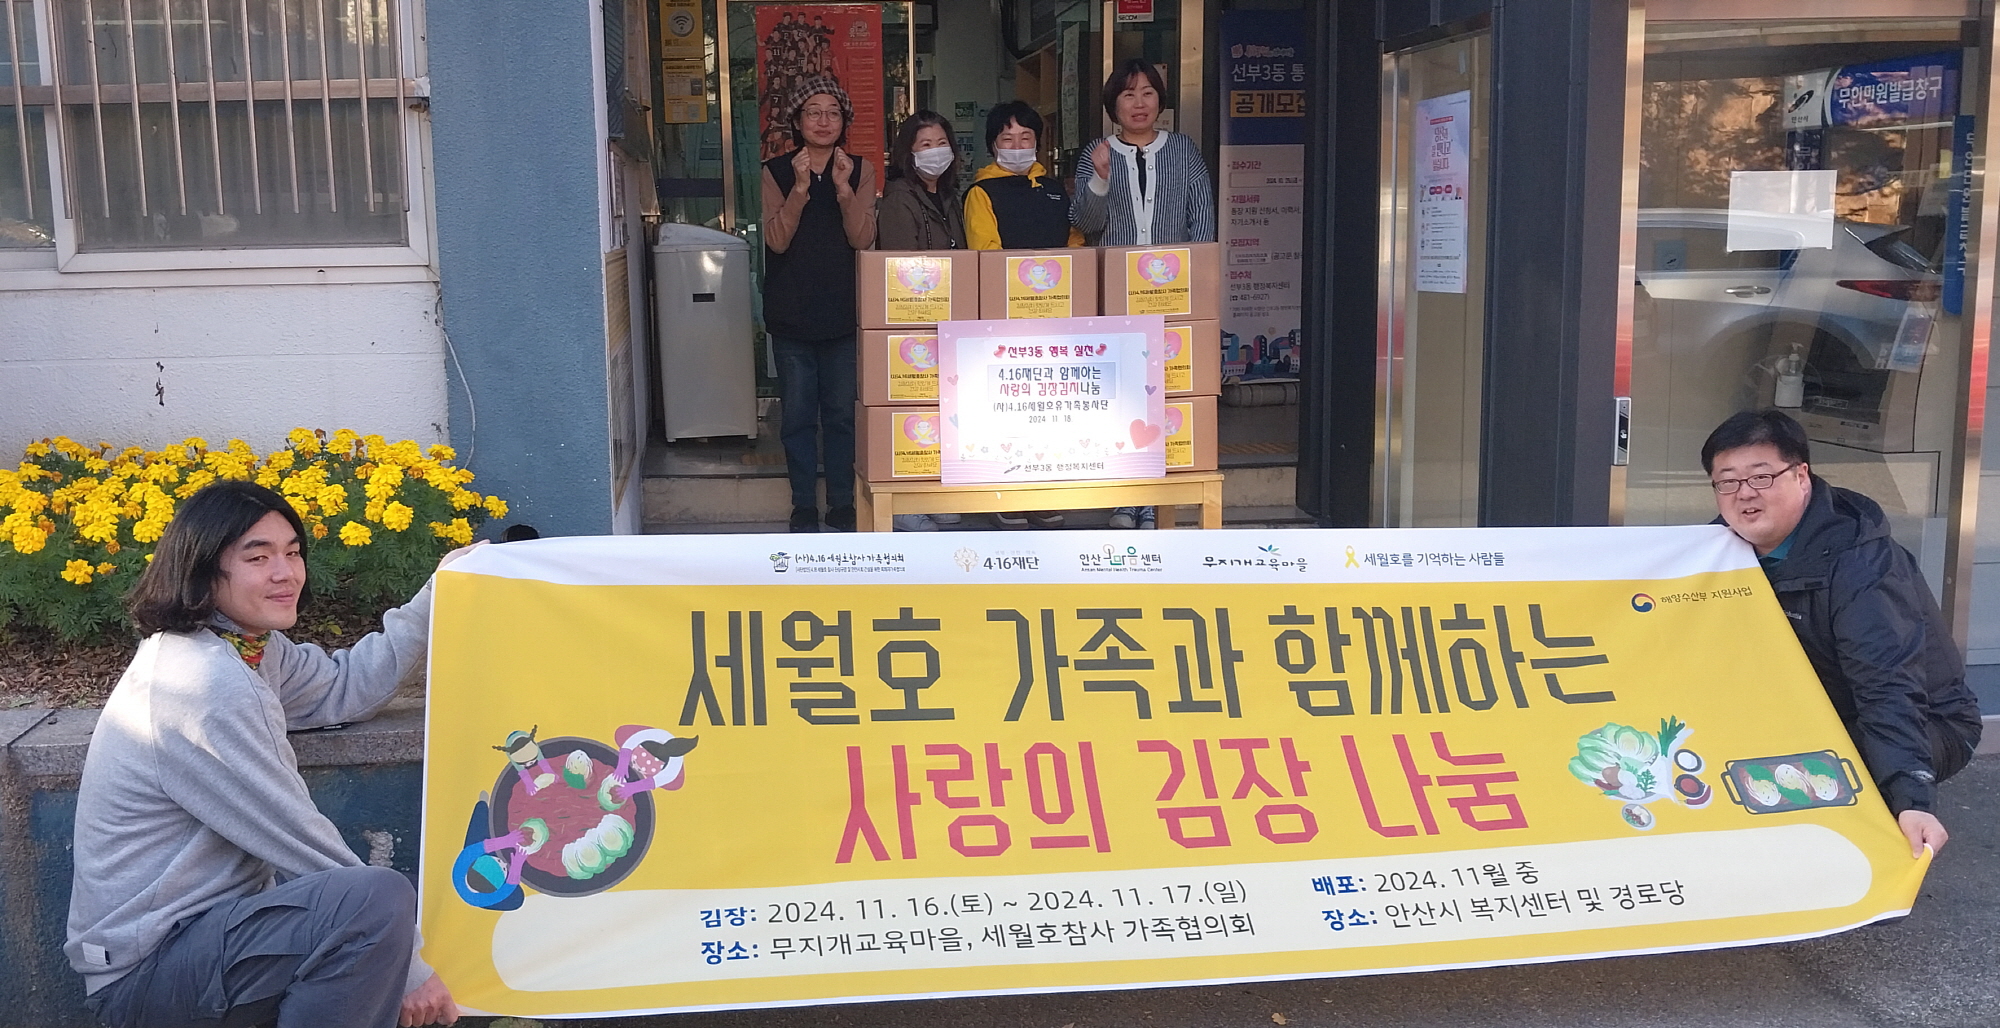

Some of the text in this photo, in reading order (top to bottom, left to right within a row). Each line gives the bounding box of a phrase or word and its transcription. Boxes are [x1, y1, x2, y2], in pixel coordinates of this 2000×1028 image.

[1231, 63, 1287, 82] 선부3동
[1838, 76, 1943, 109] 무인민원발급창구
[1008, 344, 1094, 358] 선부3동 행복 실천
[998, 367, 1053, 381] 4.16재단과
[1000, 381, 1101, 397] 사랑의 김장김치나눔
[1202, 556, 1308, 573] 무지개교육마을
[1364, 551, 1505, 567] 세월호를 기억하는 사람들
[1660, 586, 1753, 604] 해양수산부 지원사업
[678, 603, 1617, 727] 세월호 가족과 함께하는
[834, 730, 1530, 865] 사랑의 김장 나눔
[1311, 860, 1539, 897] 배포: 2024. 11월 중
[699, 907, 758, 929] 김장:
[767, 901, 845, 925] 2024.
[856, 898, 897, 920] 11.
[907, 890, 994, 918] 16.(토)
[1028, 889, 1104, 912] 2024.
[1112, 886, 1154, 908] 11.
[1161, 879, 1248, 905] 17.(일)
[1322, 879, 1687, 932] 장소: 안산시 복지센터 및 경로당
[700, 911, 1257, 966] 장소: 무지개교육마을, 세월호참사 가족협의회
